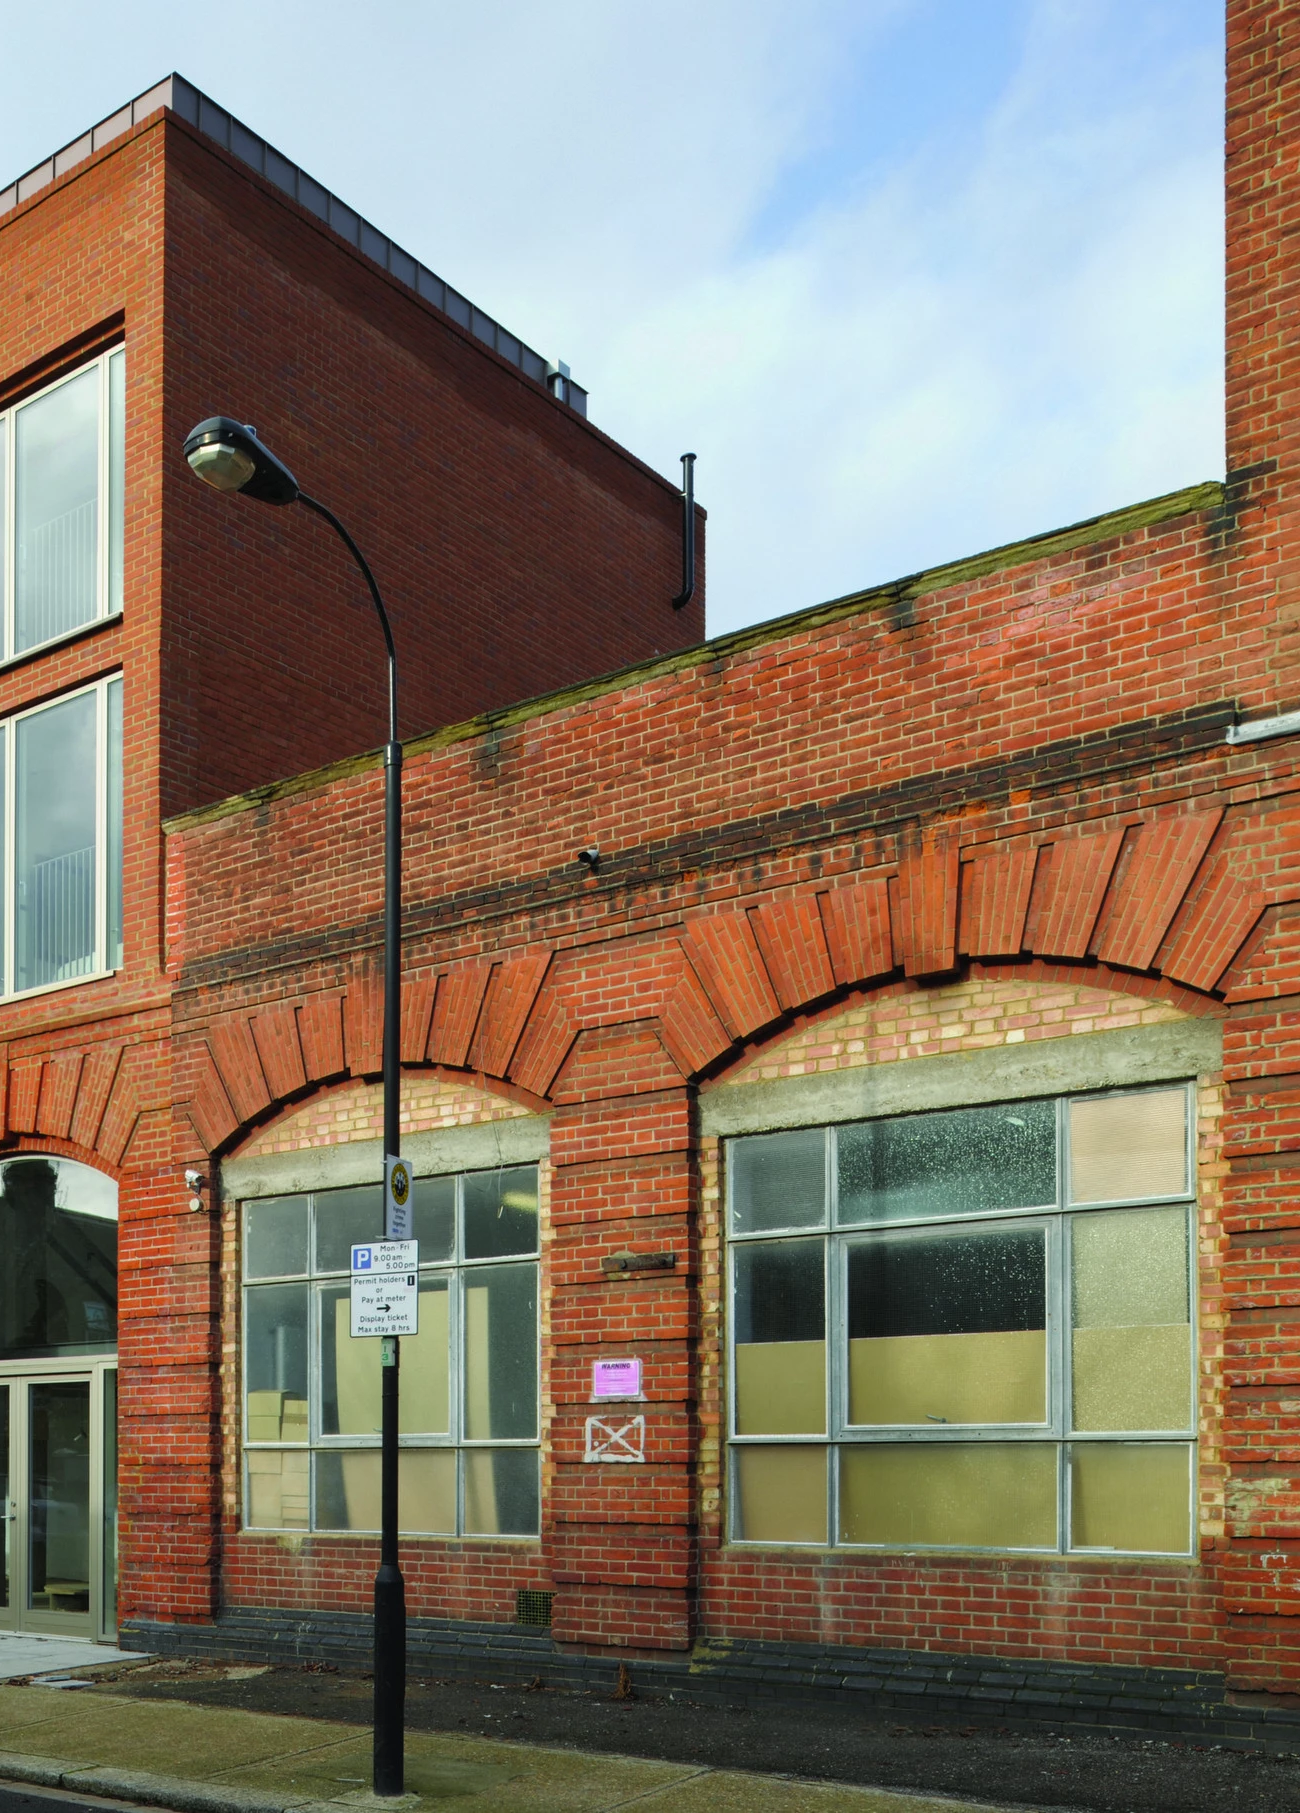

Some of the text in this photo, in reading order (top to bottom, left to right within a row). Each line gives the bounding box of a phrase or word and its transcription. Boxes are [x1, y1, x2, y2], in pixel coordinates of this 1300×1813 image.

[357, 1250, 370, 1268] P
[379, 1276, 406, 1284] holders
[361, 1296, 374, 1304] Pay
[360, 1315, 385, 1323] Display
[381, 1353, 389, 1361] 3
